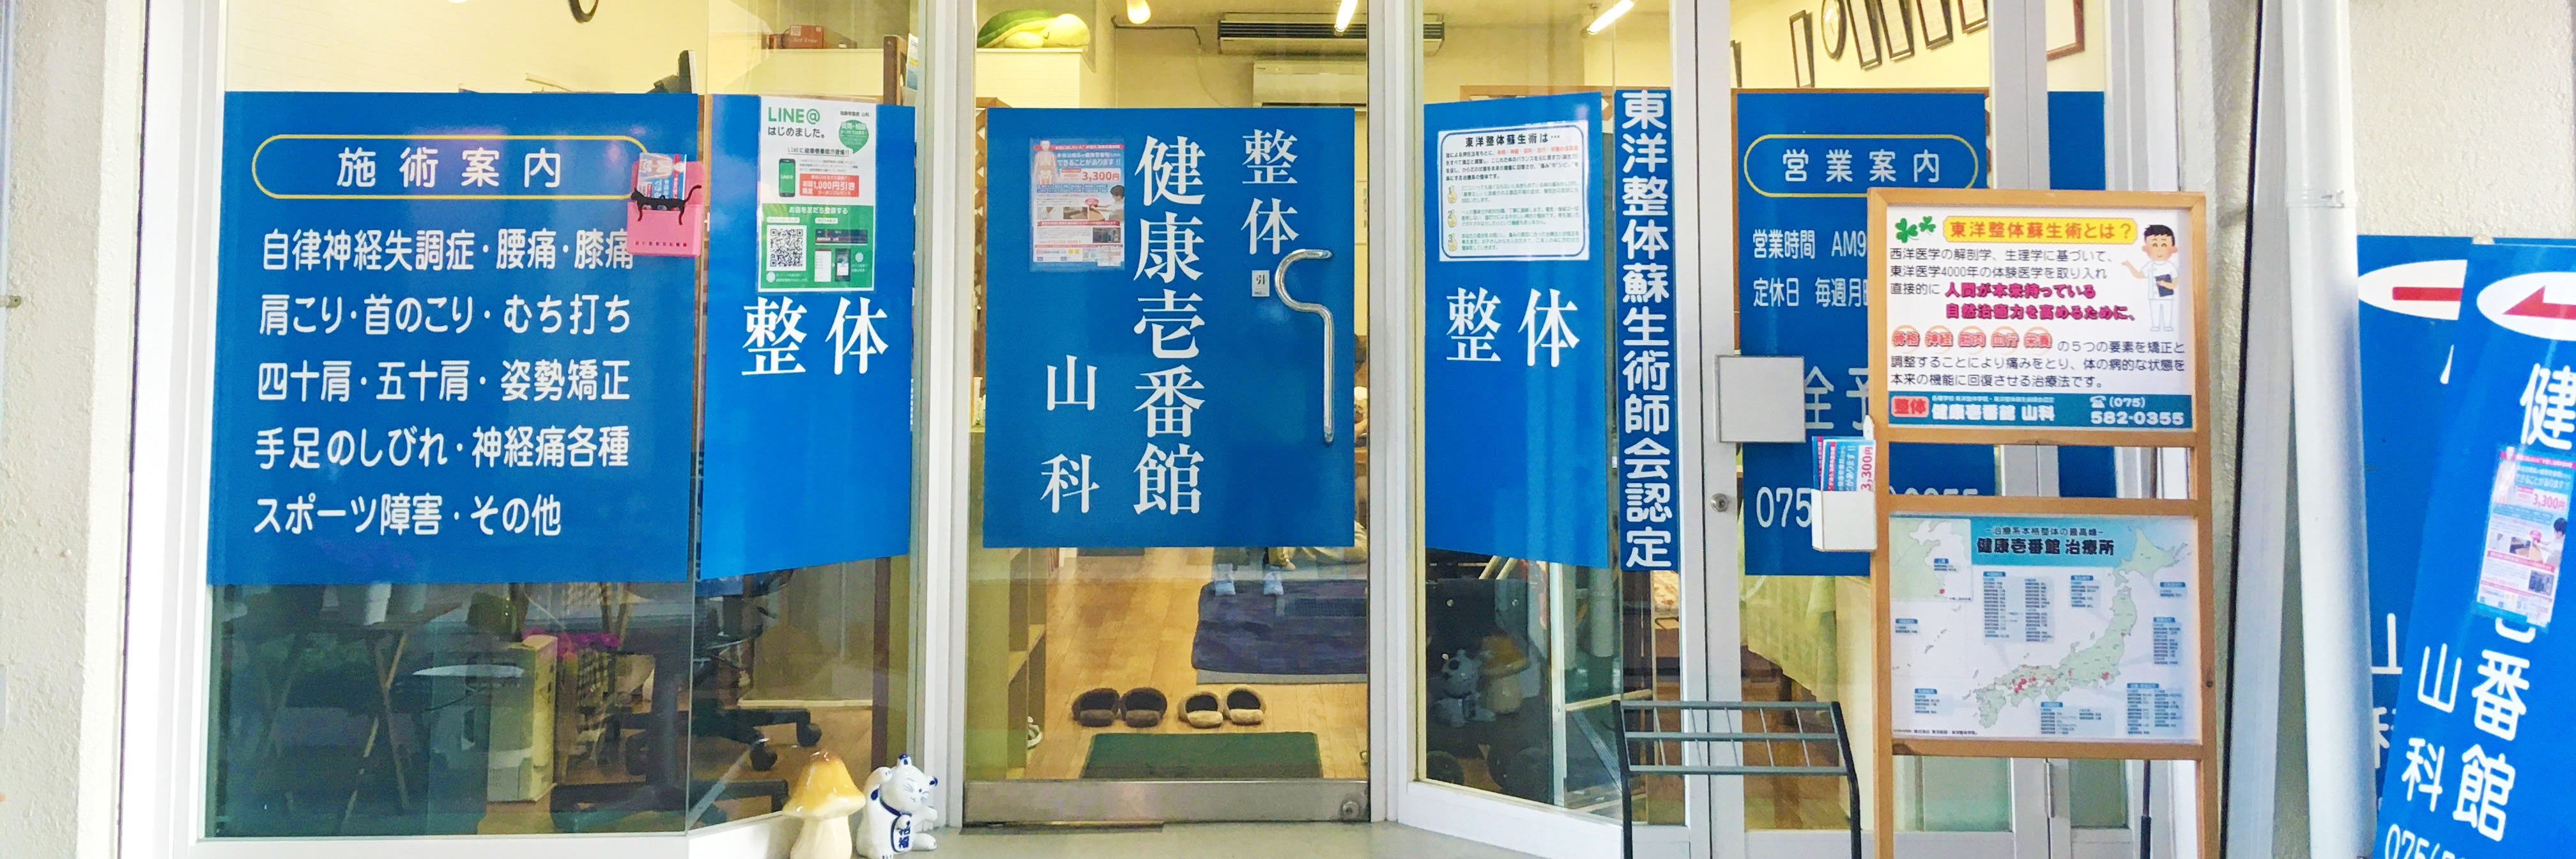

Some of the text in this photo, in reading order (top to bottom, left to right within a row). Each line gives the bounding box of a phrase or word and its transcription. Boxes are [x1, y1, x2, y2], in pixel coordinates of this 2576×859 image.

[768, 107, 820, 125] LINE@
[768, 126, 825, 139] はじめました。
[337, 146, 562, 188] 施術案内
[1082, 171, 1120, 182] 3,300円
[1782, 149, 1940, 183] 営業案内
[1241, 128, 1300, 255] 整体
[1753, 228, 1815, 260] 営業時間
[1256, 274, 1265, 285] 引
[1890, 265, 2108, 279] 東洋医学4000年の体験医学を取り入れ
[1753, 277, 1800, 307] 定休日
[1890, 282, 2096, 299] 直接的に 人間が本来持っている
[259, 294, 631, 336] 肩こり・首のこり・むち打ち
[1133, 135, 1206, 515] 健康壱番館
[1446, 286, 1581, 368] 整体
[1946, 303, 2135, 321] 自然治癒力を高めるために、
[742, 295, 889, 376] 整体
[1621, 90, 1673, 570] 東洋整体蘇生術師会認定
[1892, 330, 1920, 347] 骨格
[1924, 331, 1954, 348] 神経
[1890, 355, 2185, 372] 調整することにより痛みをとり、体の病的な状態を
[257, 359, 631, 403] 四十肩・五十肩・姿勢矯正
[1890, 373, 2102, 388] 本来の機能に回復させる治療法です。
[1894, 398, 1926, 415] 整体
[2110, 397, 2145, 408] (075)
[1040, 354, 1100, 514] 山科
[2090, 411, 2185, 426] 582-0355
[255, 425, 630, 469] 手足のしびれ・神経痛各種
[254, 493, 562, 536] スポーツ障害・その他
[1977, 538, 2114, 555] 健康壱番館 治療所
[2452, 361, 2576, 842] 健番館
[2401, 643, 2462, 812] 山科
